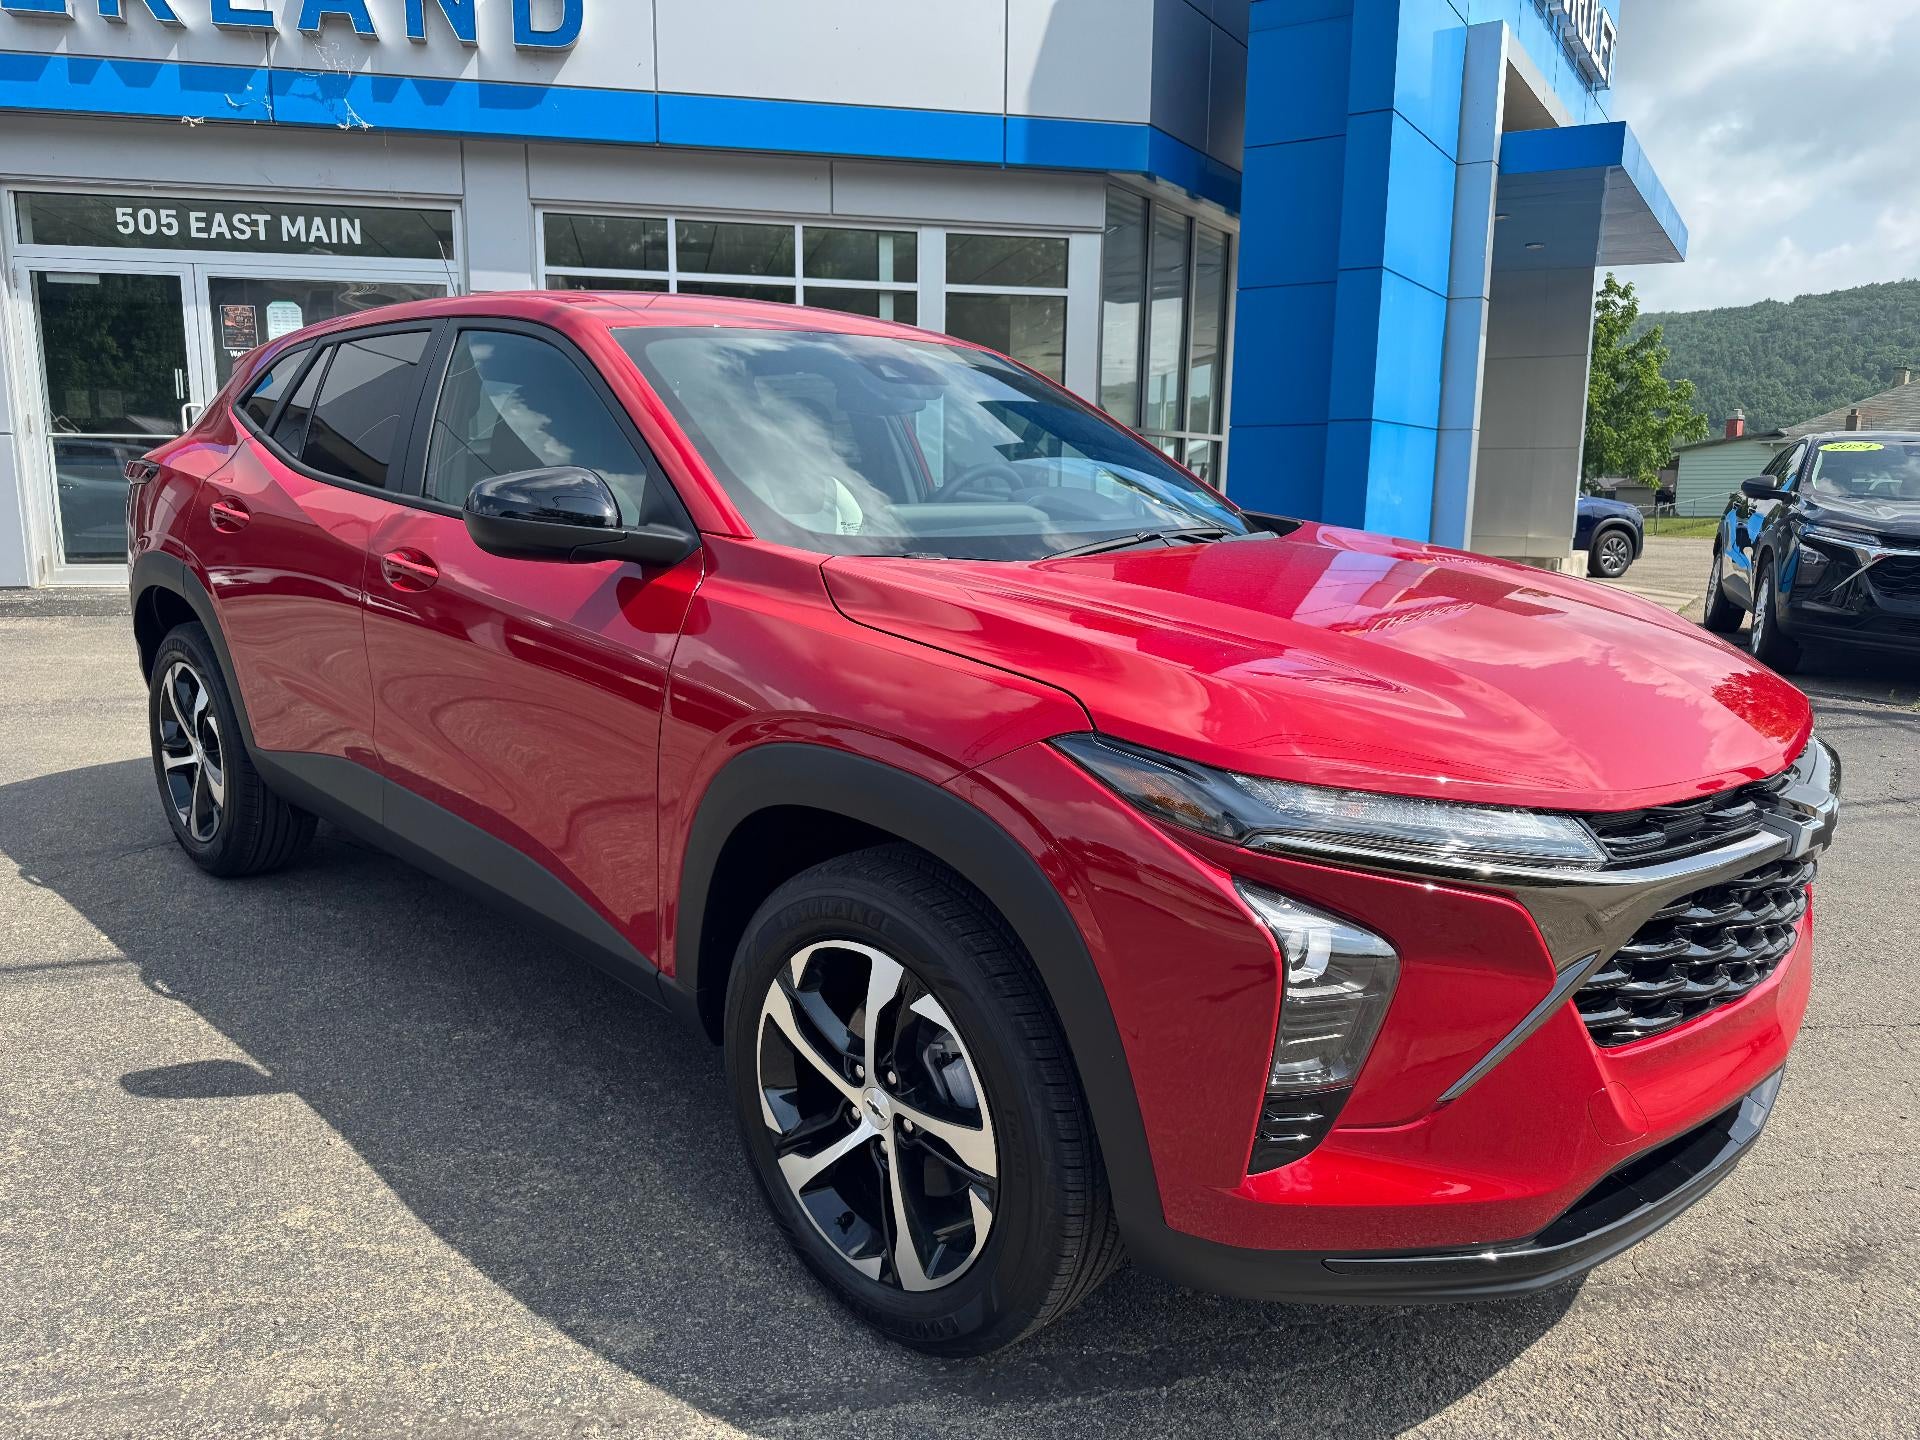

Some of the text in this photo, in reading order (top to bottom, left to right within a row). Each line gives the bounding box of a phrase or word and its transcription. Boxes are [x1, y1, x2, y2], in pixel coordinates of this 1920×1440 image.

[116, 208, 361, 245] 505 EAST MAIN
